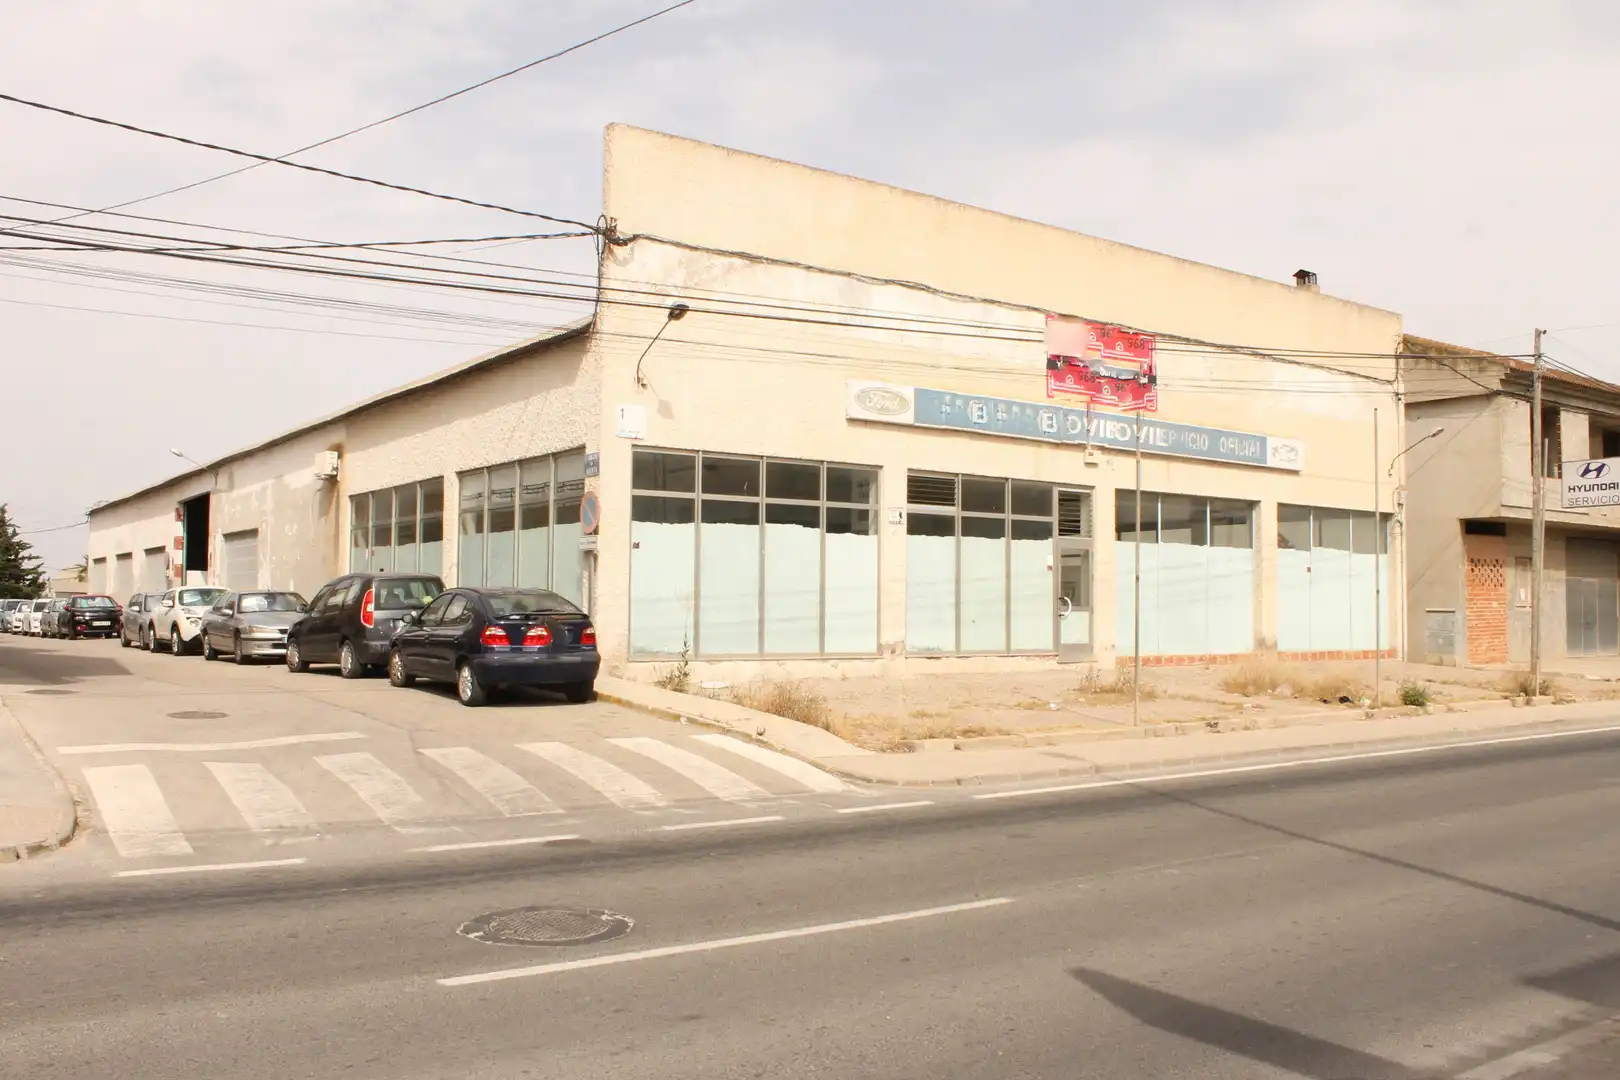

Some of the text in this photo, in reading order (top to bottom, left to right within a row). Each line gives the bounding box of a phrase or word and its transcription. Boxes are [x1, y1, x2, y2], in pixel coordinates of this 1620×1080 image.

[866, 390, 901, 410] Ford
[1568, 482, 1619, 493] HYUNDAI
[1568, 494, 1620, 507] SERVICIO
